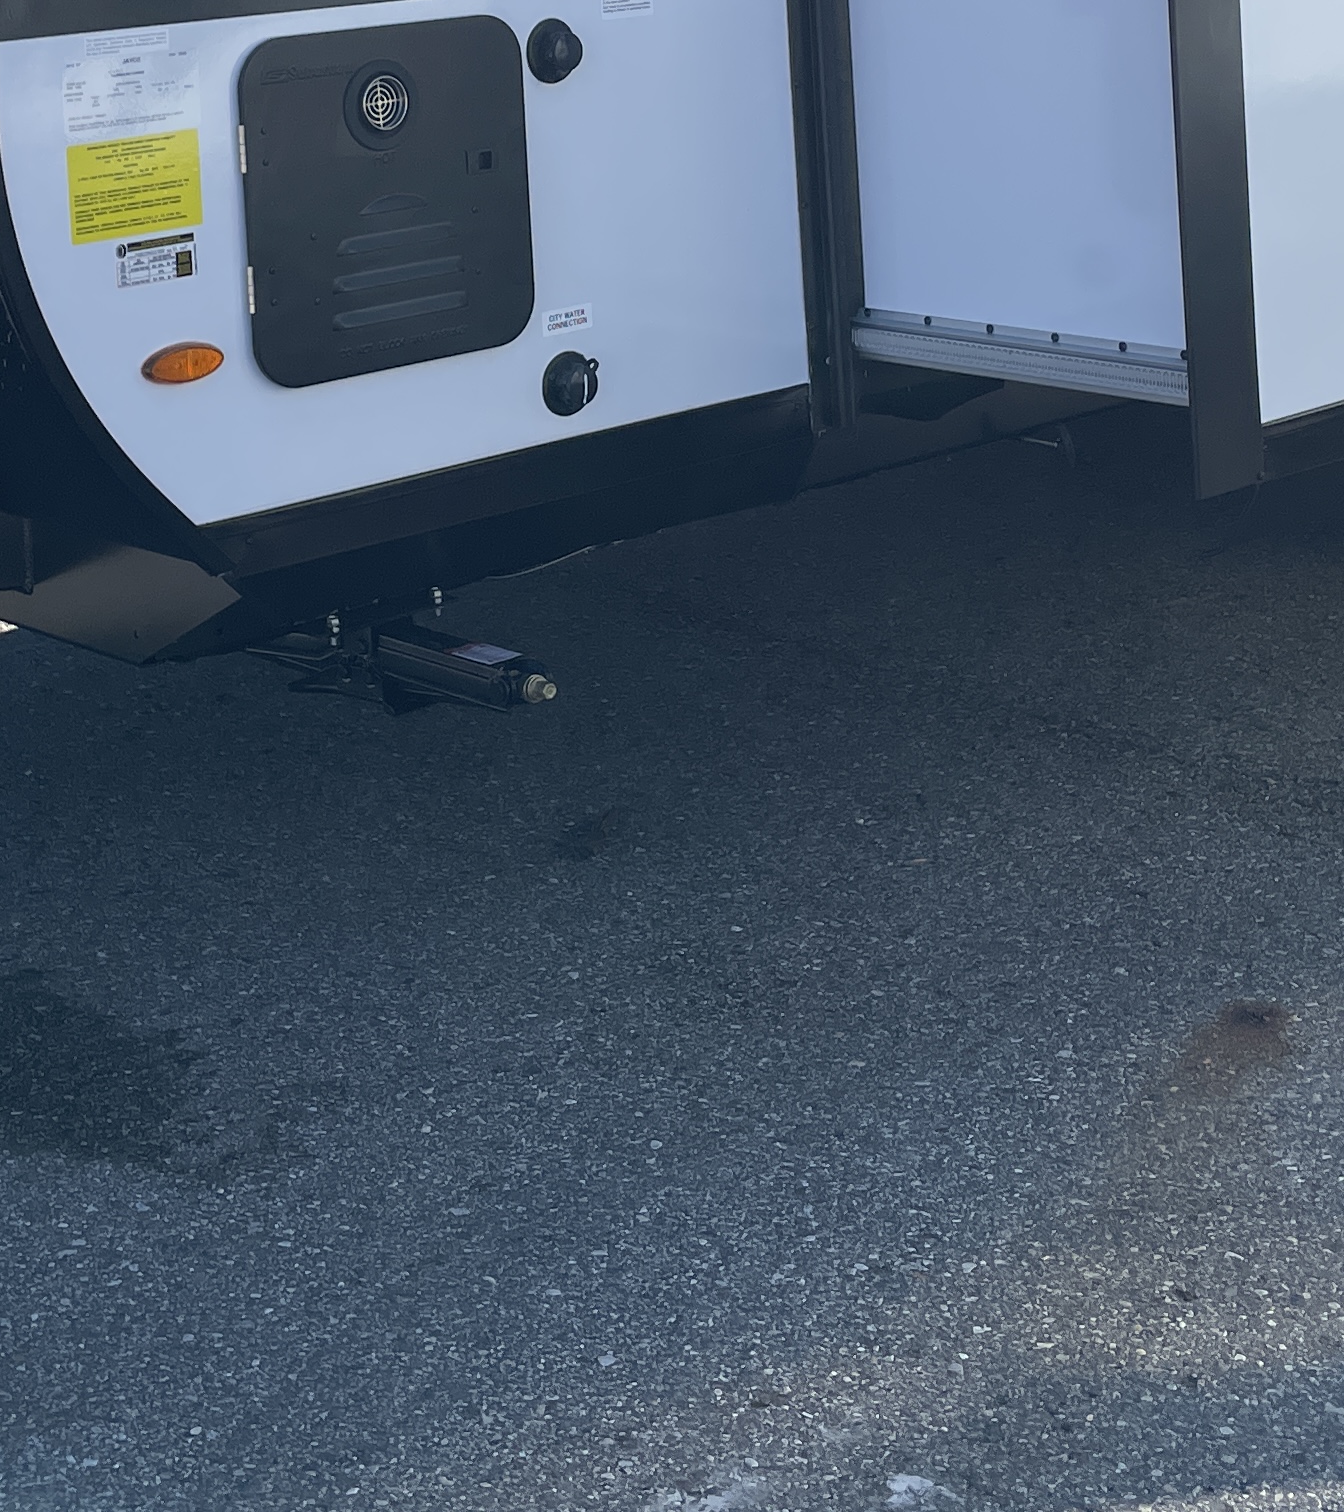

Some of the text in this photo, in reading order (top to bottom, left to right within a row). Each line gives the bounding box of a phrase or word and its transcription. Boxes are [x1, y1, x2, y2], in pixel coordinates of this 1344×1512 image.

[548, 308, 586, 323] CITY WATER
[547, 317, 588, 332] CONNECTION
